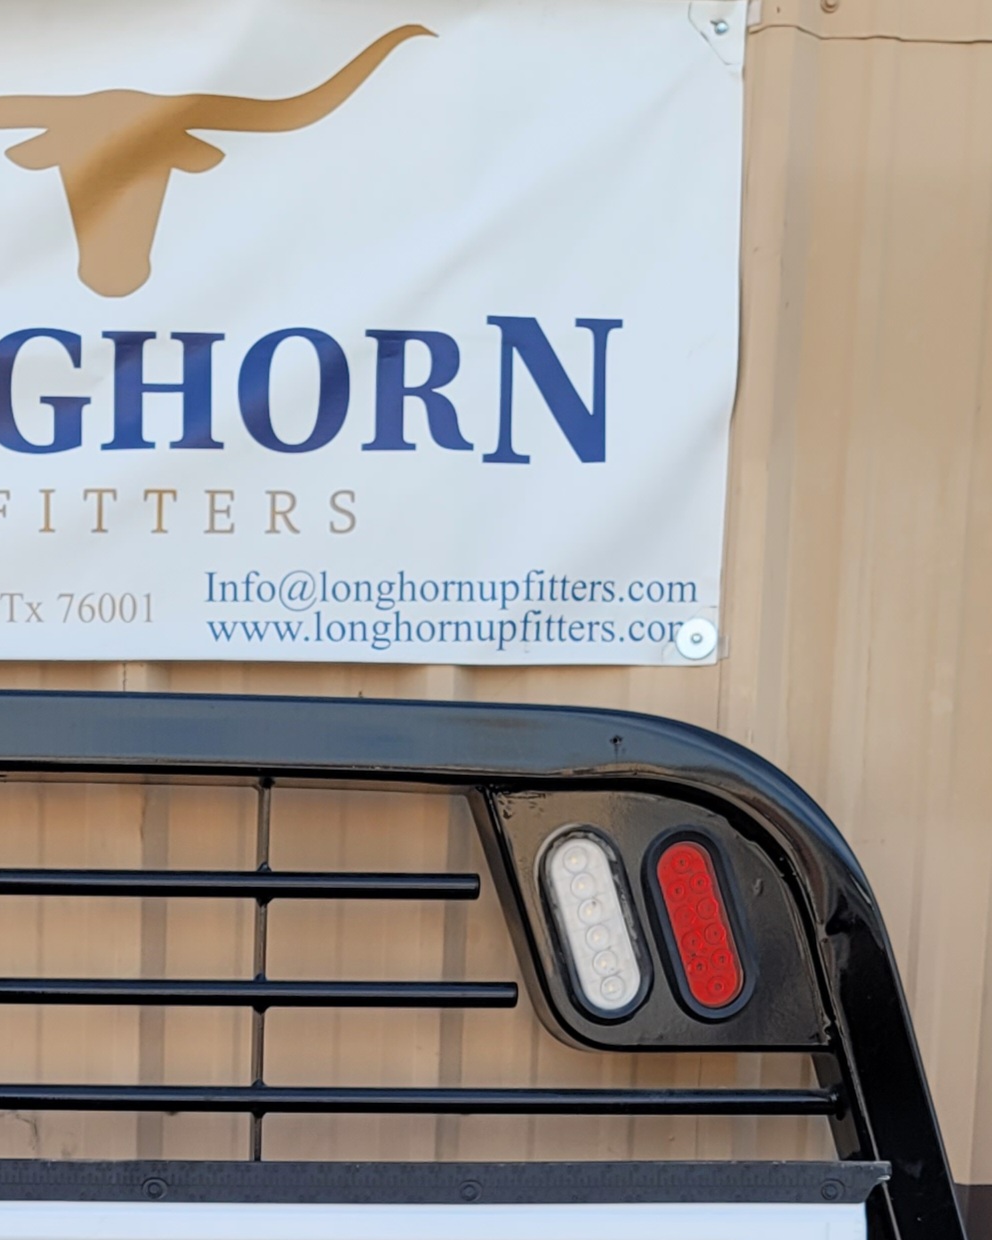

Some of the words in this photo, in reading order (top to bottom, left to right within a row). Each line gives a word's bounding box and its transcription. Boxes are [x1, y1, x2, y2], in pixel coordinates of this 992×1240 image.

[0, 592, 44, 623] Tx
[57, 592, 154, 624] 76001
[205, 570, 698, 612] Info@longhornupfitters.com
